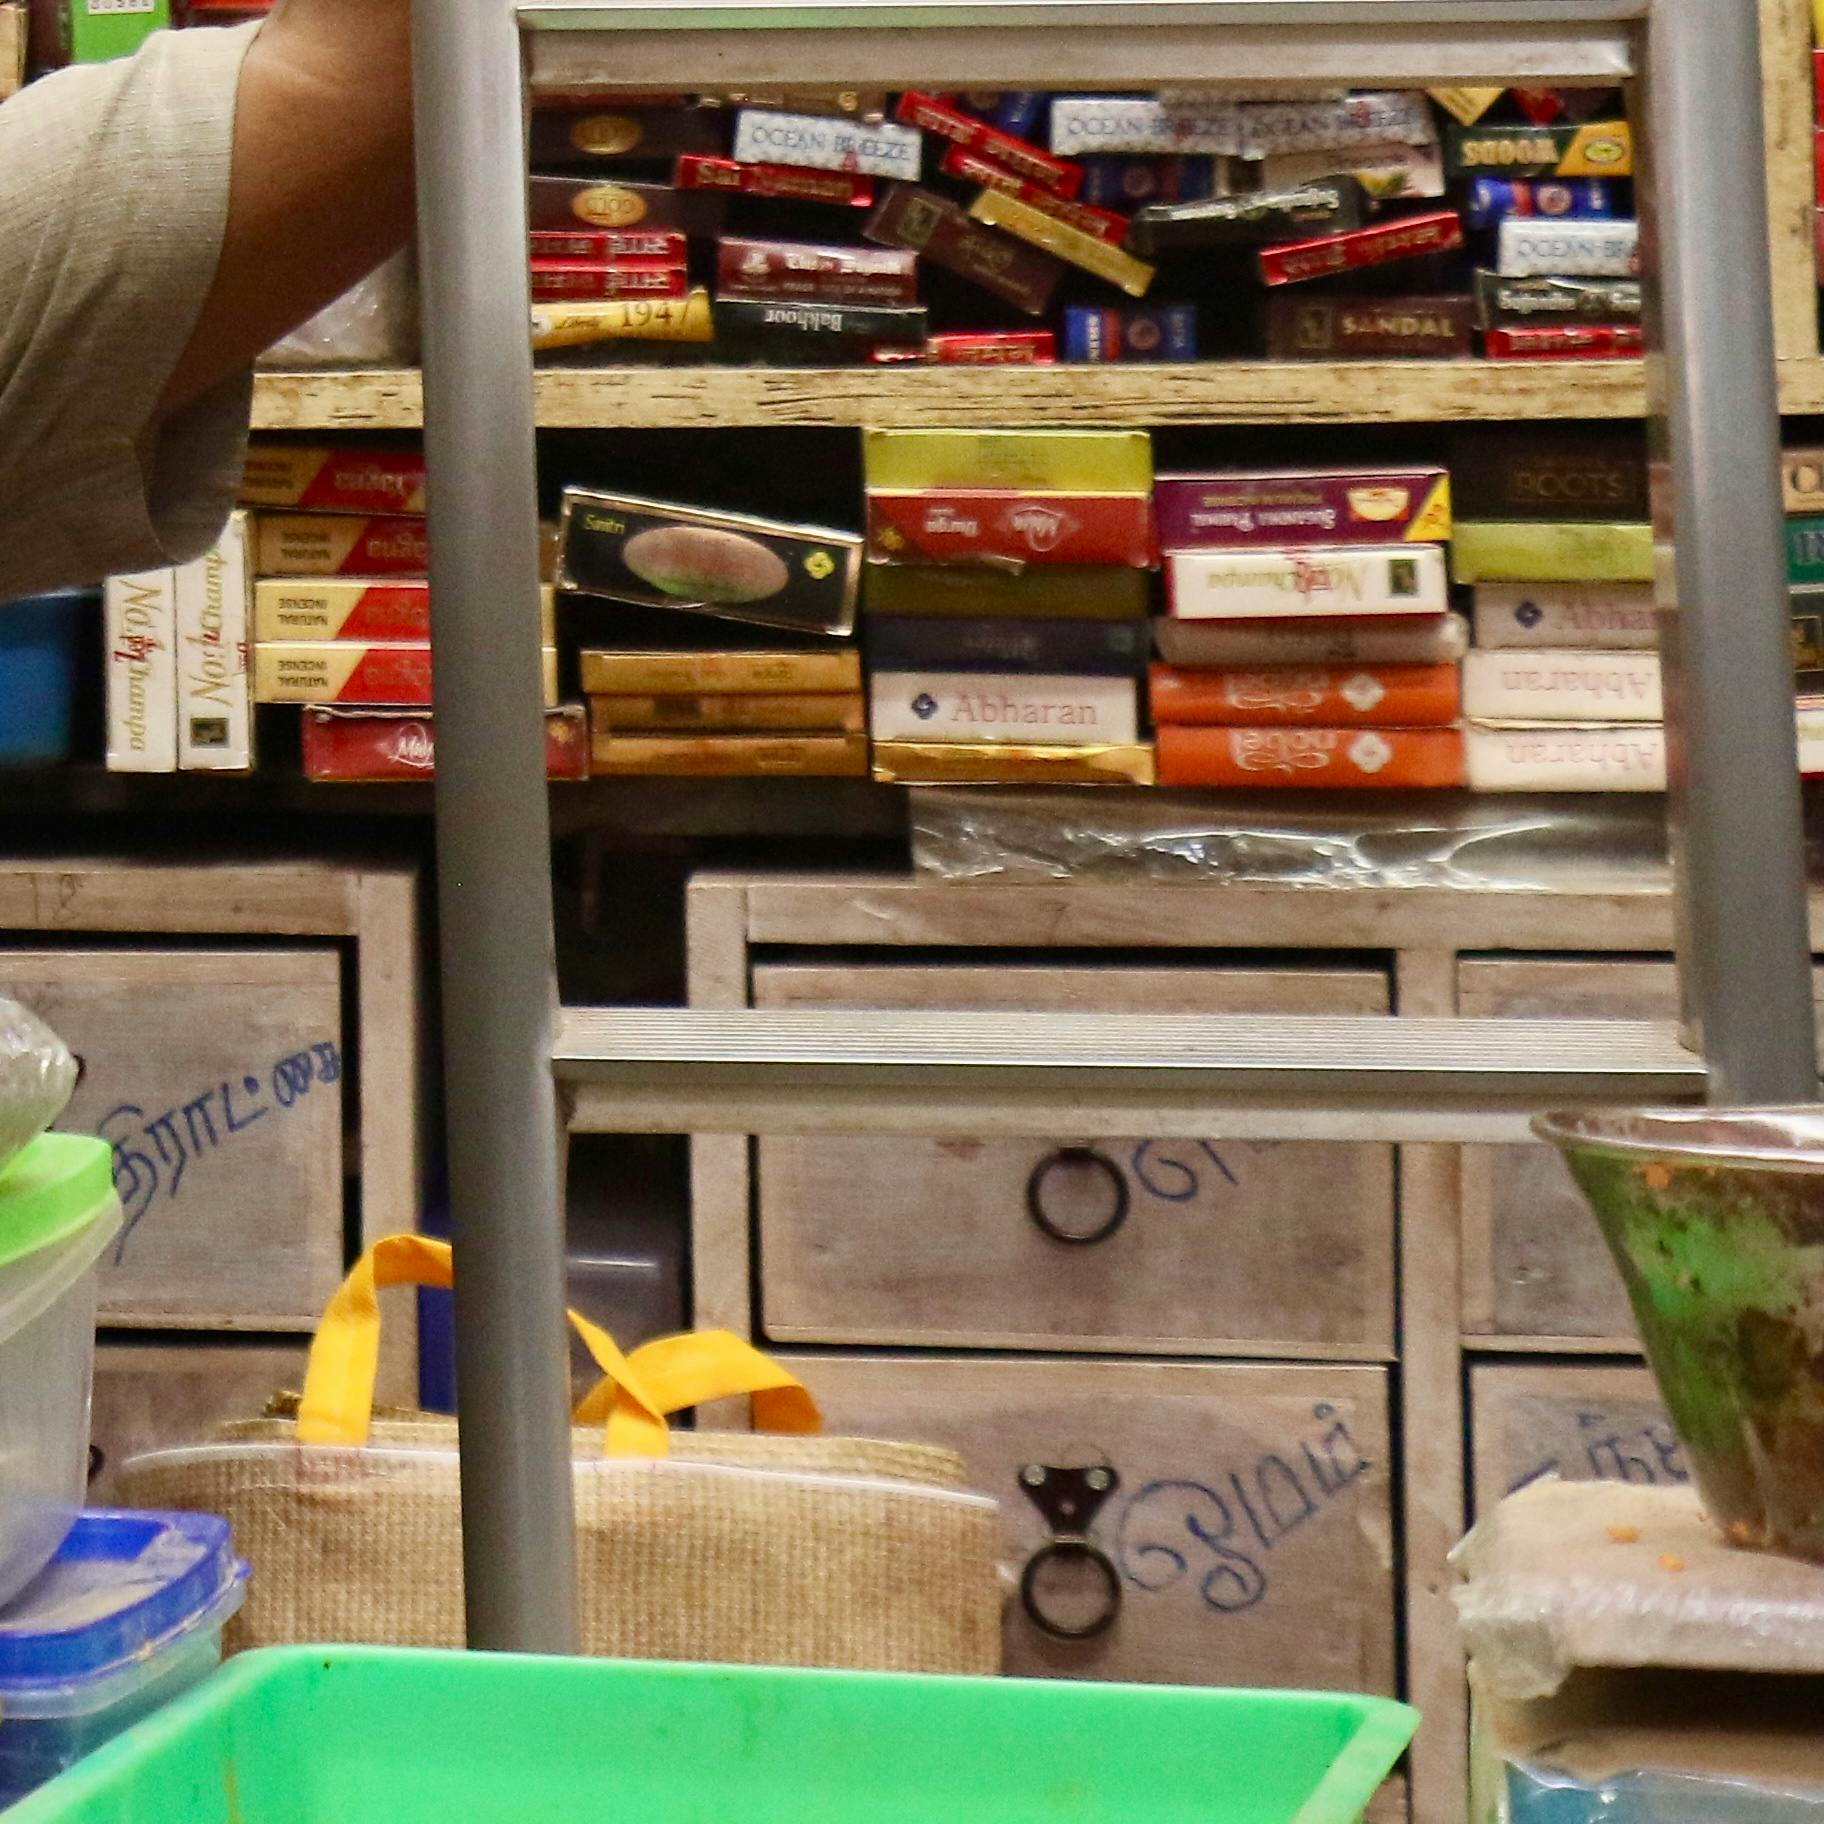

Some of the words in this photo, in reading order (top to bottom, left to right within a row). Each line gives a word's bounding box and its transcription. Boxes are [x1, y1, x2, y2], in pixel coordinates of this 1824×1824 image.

[1065, 113, 1146, 138] OCEAN
[752, 125, 825, 153] OCEAN
[1461, 138, 1559, 169] WOODS
[1516, 236, 1594, 259] OCEAN
[765, 309, 842, 331] Bakhoor
[1341, 314, 1454, 337] SANDAL
[277, 598, 327, 611] INCENSE
[277, 613, 328, 626] NATURAL
[277, 660, 327, 672] INCENSE
[277, 676, 329, 688] NATURAL
[951, 693, 1098, 726] Abharan
